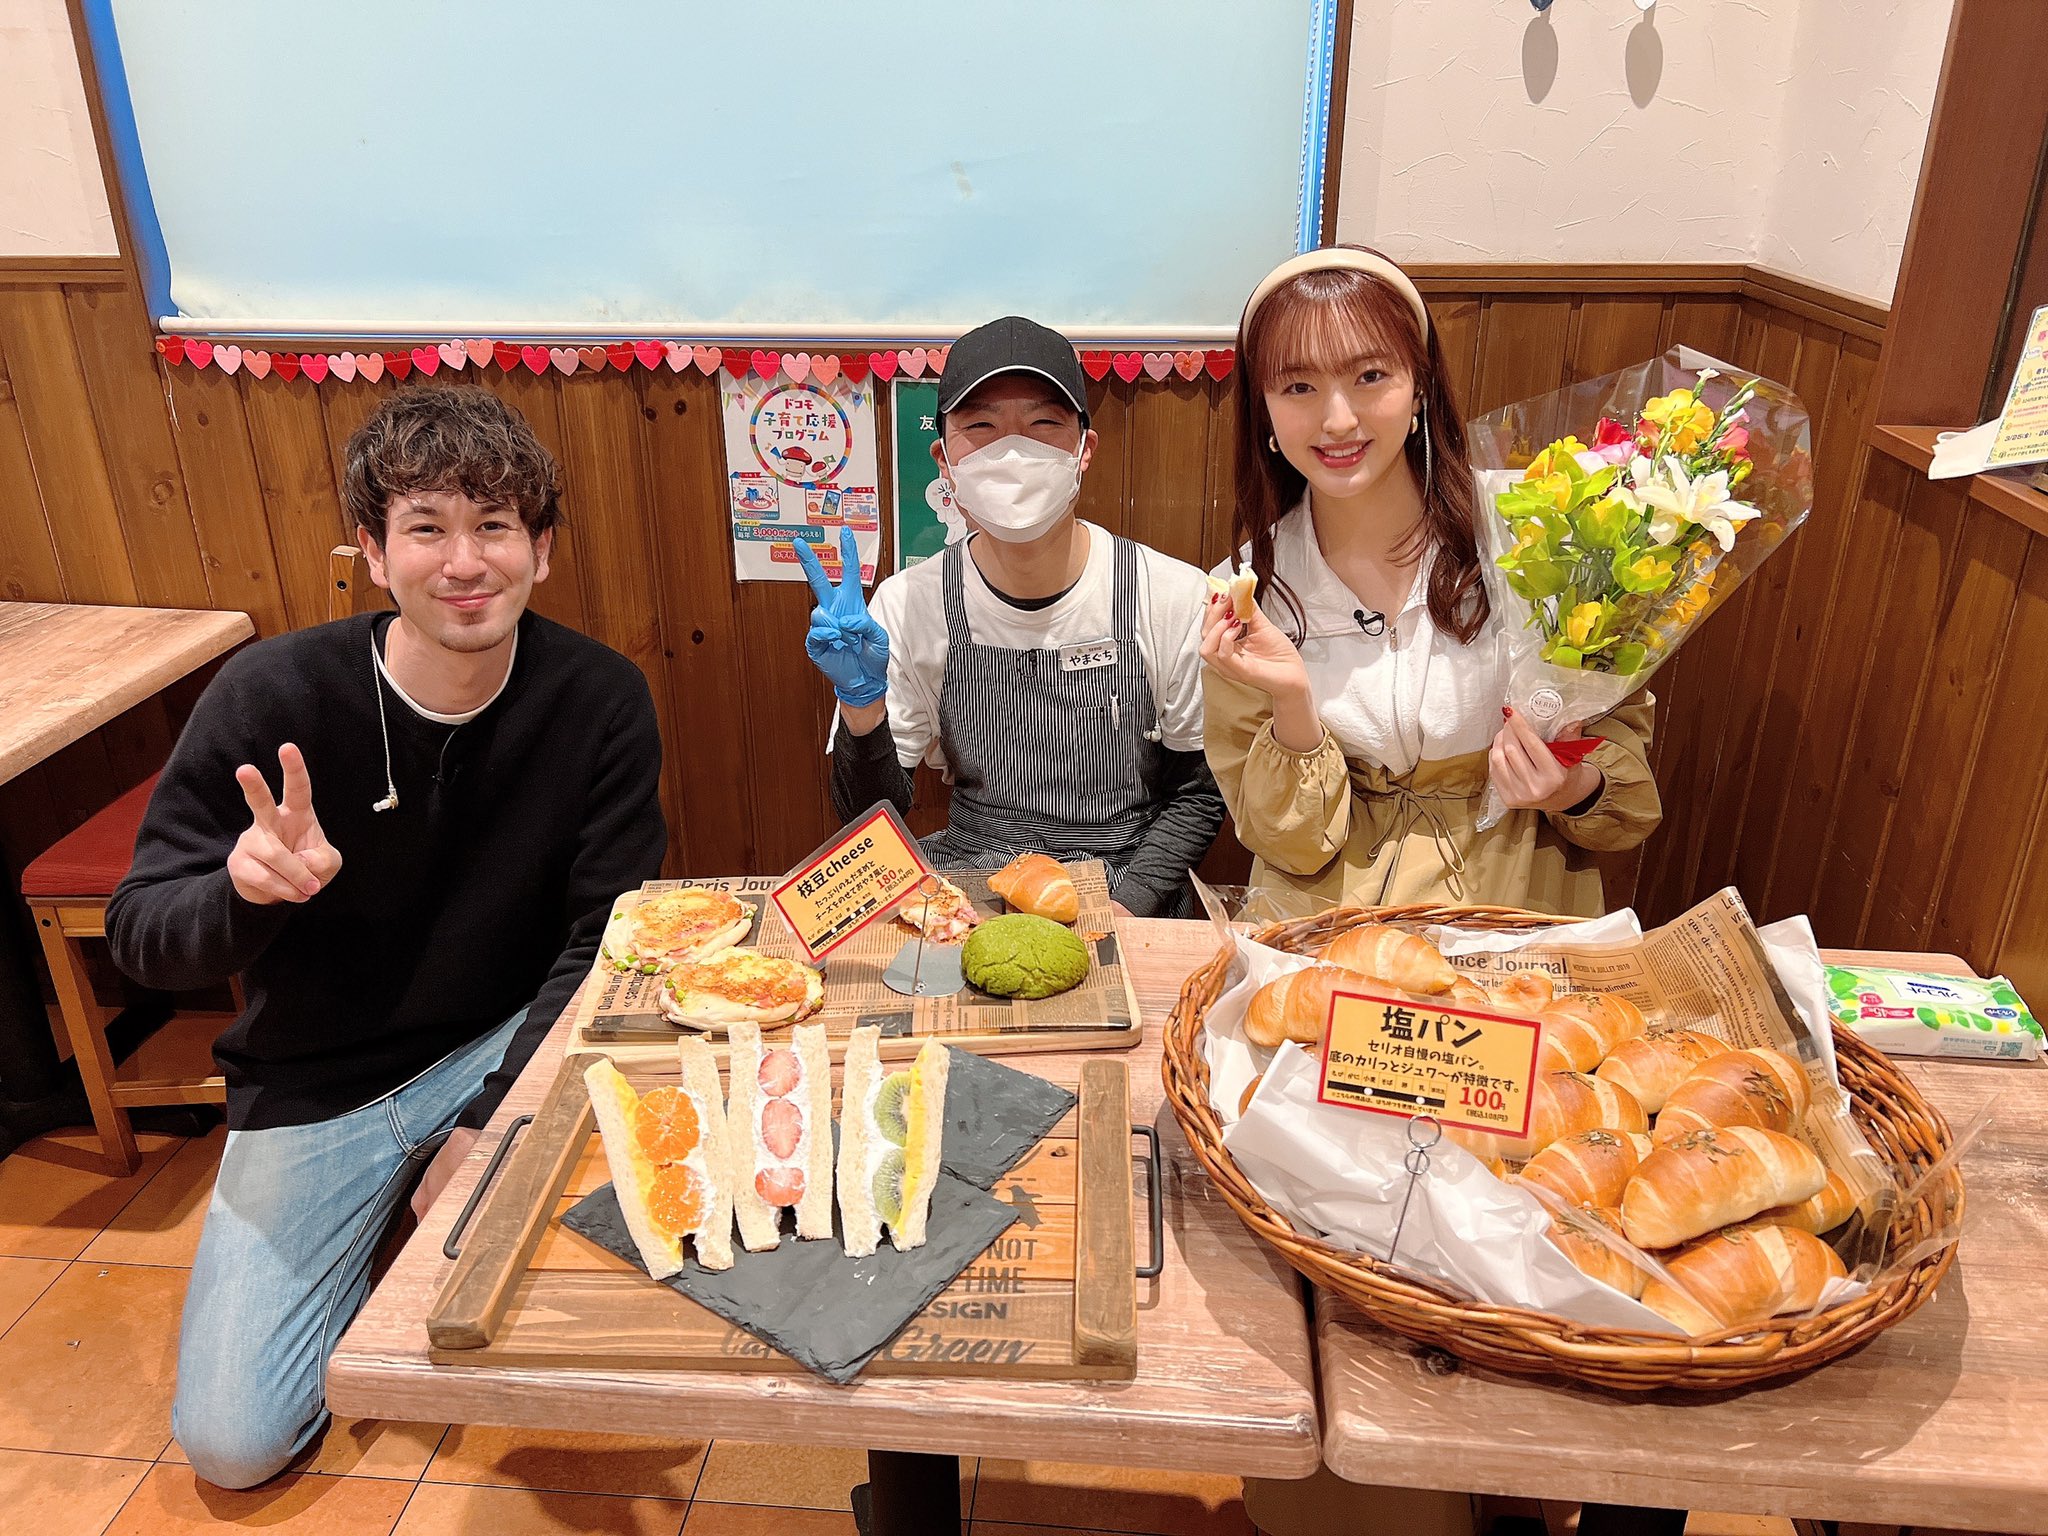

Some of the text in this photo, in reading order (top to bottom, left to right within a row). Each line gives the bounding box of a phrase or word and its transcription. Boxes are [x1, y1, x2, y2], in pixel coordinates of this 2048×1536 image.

[785, 398, 814, 410] ドコモ
[763, 412, 837, 428] 子育て応援
[920, 415, 937, 430] 友
[772, 427, 830, 442] プログラム
[773, 551, 799, 559] 小学校
[1069, 650, 1113, 666] やまぐち
[796, 836, 874, 899] 枝豆cheese
[736, 877, 776, 892] Jou
[814, 860, 876, 909] たっぷりのえだまめと
[815, 864, 888, 921] チーズをのせておやき風に
[1721, 895, 1743, 910] Les
[1731, 910, 1752, 925] vra
[1494, 956, 1568, 975] Journal
[1697, 911, 1709, 925] Je
[1708, 924, 1722, 939] me
[1719, 936, 1749, 986] souvenais
[1746, 986, 1759, 1013] alors
[1756, 1012, 1770, 1036] d'un
[625, 969, 646, 1000] sanctua
[1687, 917, 1762, 1050] que des restaurants fréquent
[598, 994, 616, 1010] Quel
[1380, 1005, 1483, 1049] 塩パン
[1367, 1039, 1485, 1071] セリオ自慢の塩パン。
[985, 1238, 1038, 1261] NOT
[962, 1266, 1026, 1294] TIME
[920, 1301, 1008, 1319] SIGN
